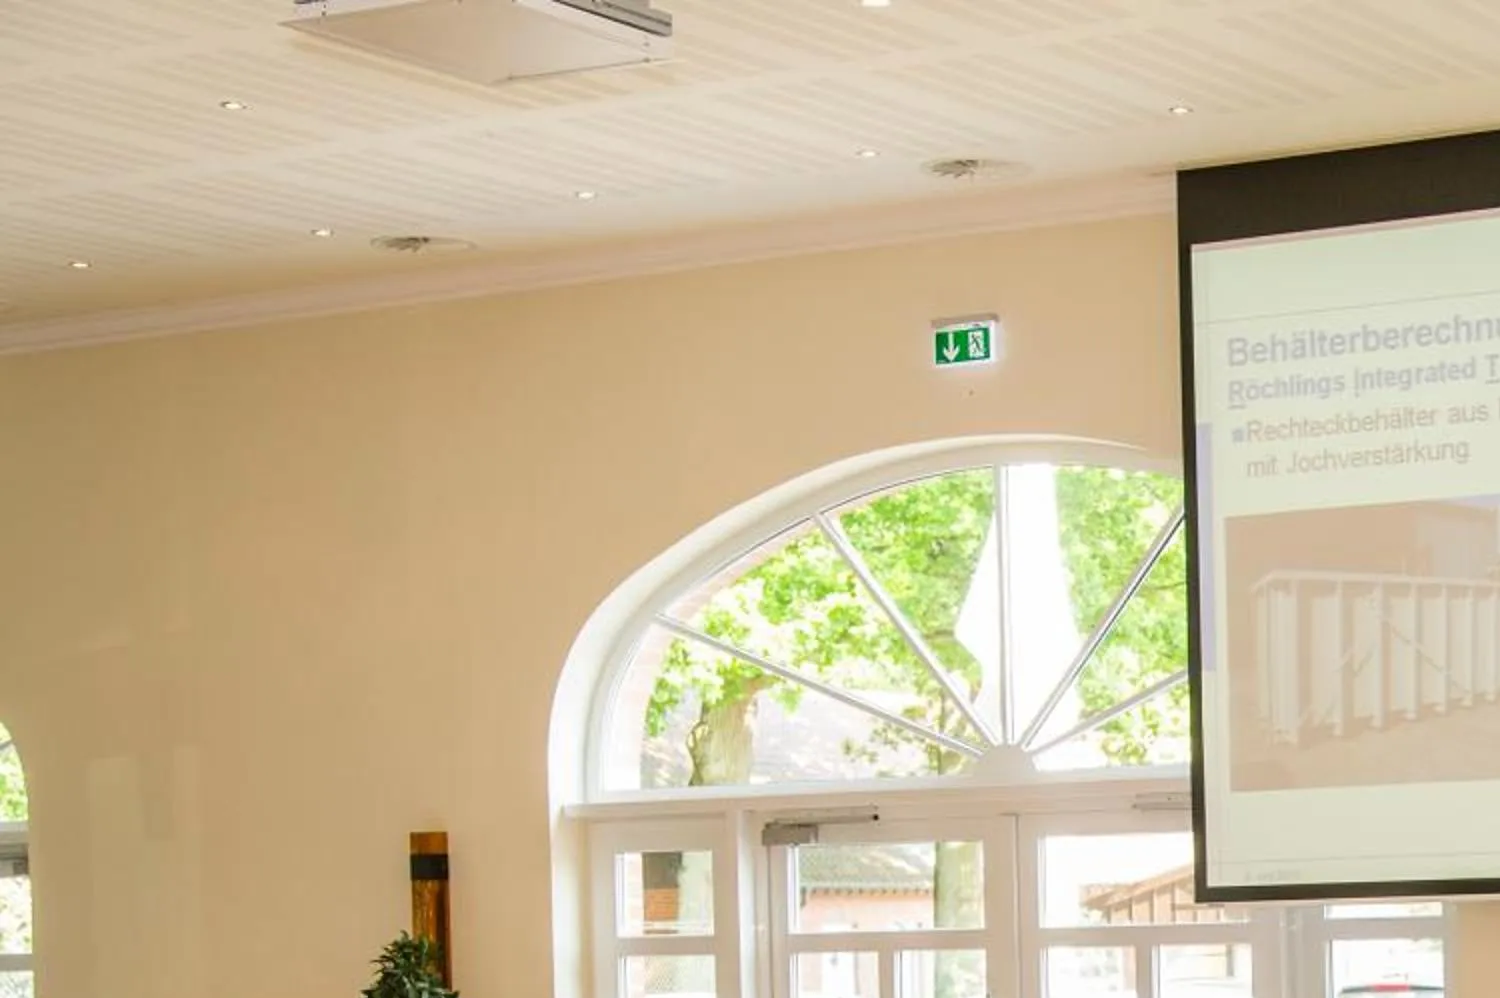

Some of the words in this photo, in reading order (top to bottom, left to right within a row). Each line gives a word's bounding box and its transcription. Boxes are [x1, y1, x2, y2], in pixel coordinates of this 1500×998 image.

[1228, 373, 1346, 404] Röchlings
[1354, 357, 1476, 393] Integrated
[1247, 408, 1438, 443] Rechteckbehälter
[1447, 402, 1489, 425] aus
[1247, 455, 1278, 477] mit
[1286, 440, 1470, 475] Jochverstärkung
